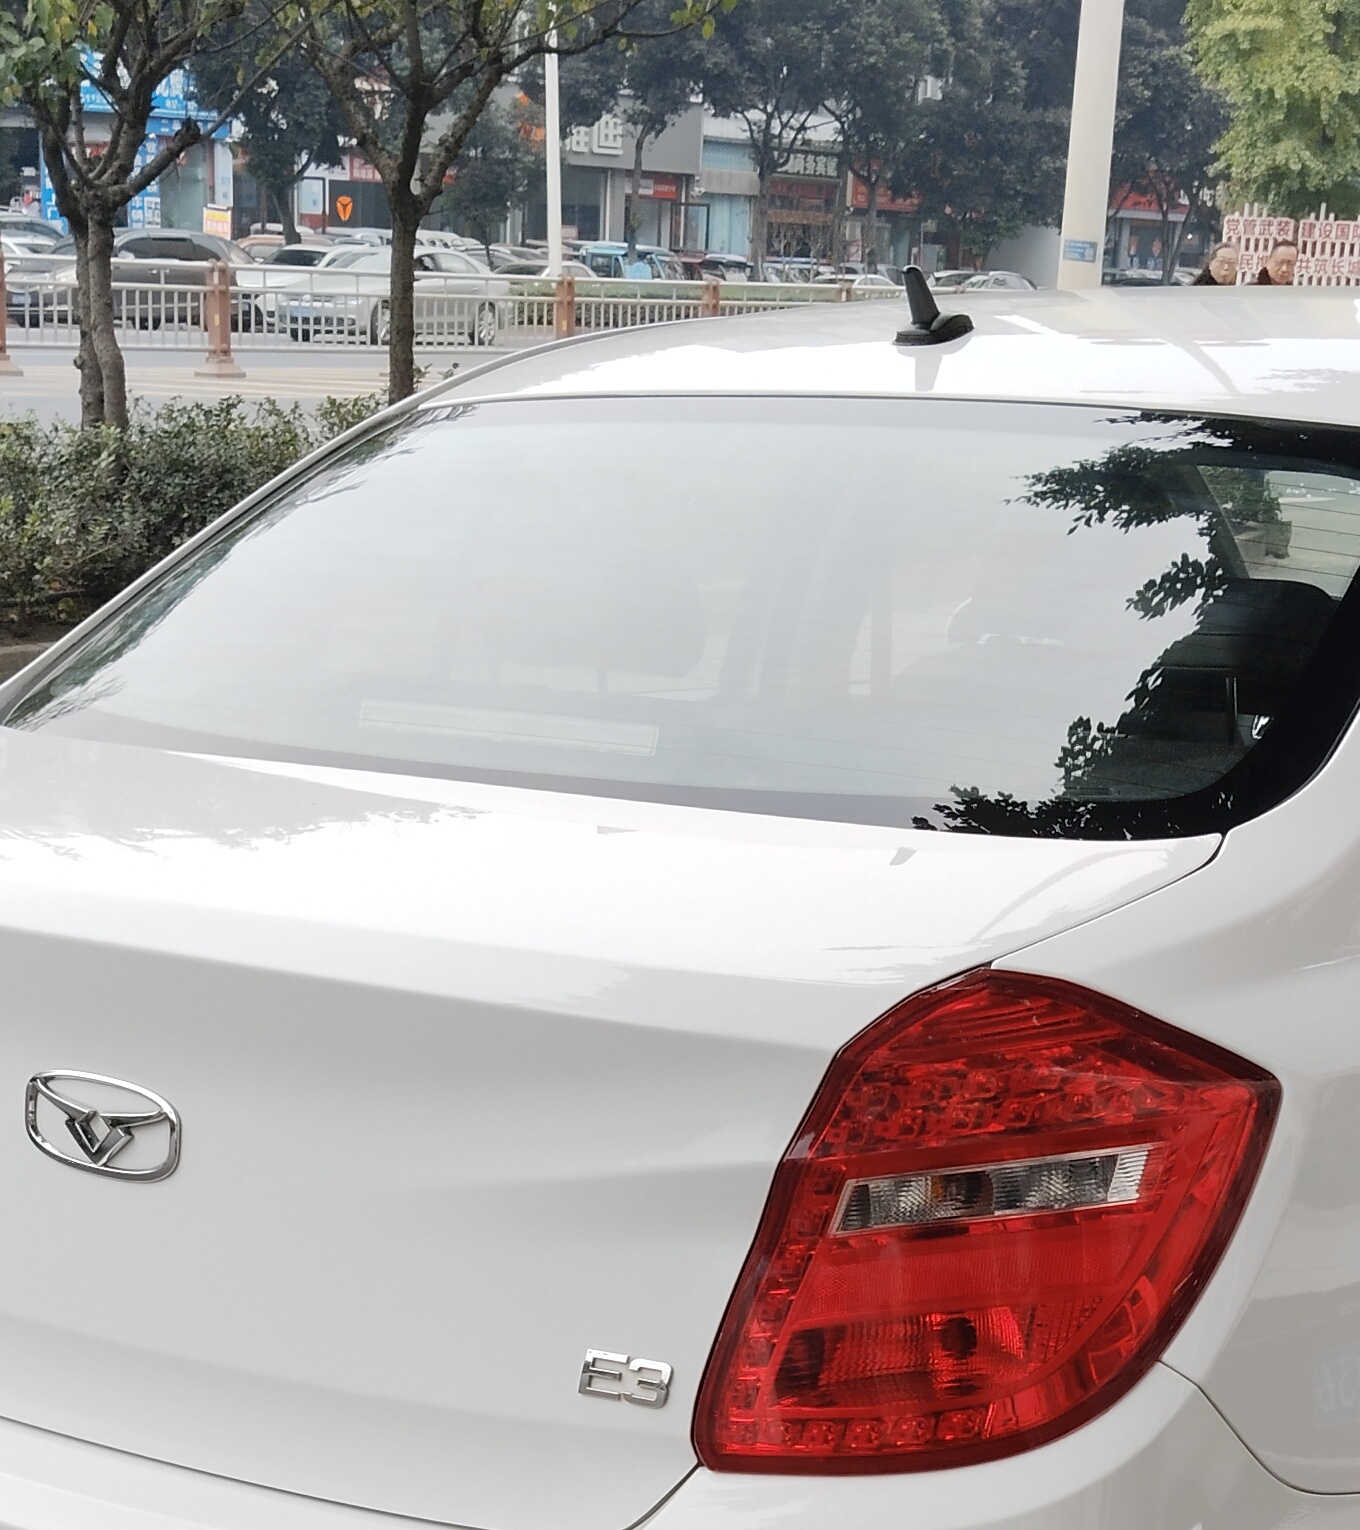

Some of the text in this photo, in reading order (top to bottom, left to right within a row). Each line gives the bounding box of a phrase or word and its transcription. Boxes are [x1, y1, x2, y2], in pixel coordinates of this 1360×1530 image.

[1226, 217, 1292, 236] 党管武装
[578, 1348, 674, 1409] E3
